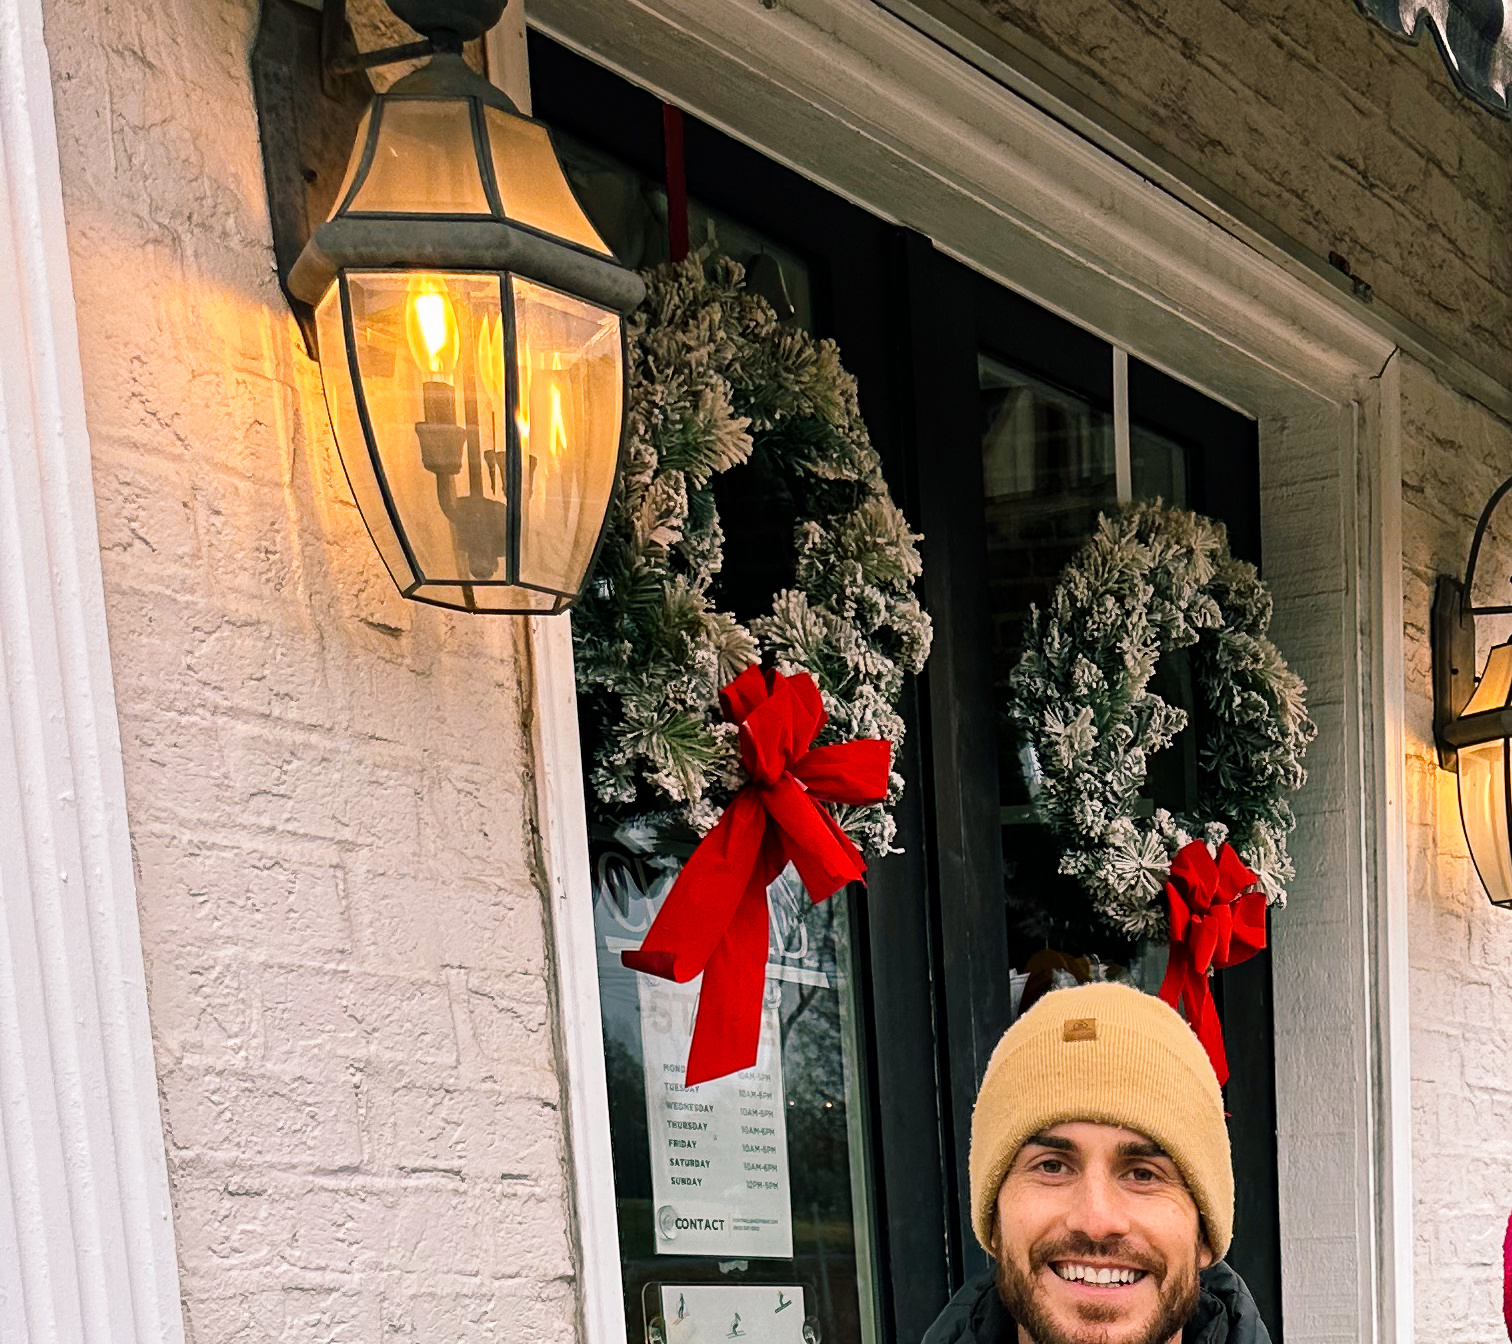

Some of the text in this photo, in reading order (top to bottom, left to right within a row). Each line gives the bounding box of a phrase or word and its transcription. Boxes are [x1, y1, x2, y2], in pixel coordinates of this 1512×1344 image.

[663, 1063, 686, 1074] MOND
[665, 1101, 714, 1113] WEDNESDAY
[667, 1120, 708, 1131] THURSDAY
[668, 1139, 697, 1149] FRIDAY
[669, 1158, 711, 1168] SATURDAY
[670, 1176, 702, 1187] SUNDAY
[675, 1218, 725, 1231] CONTACT
